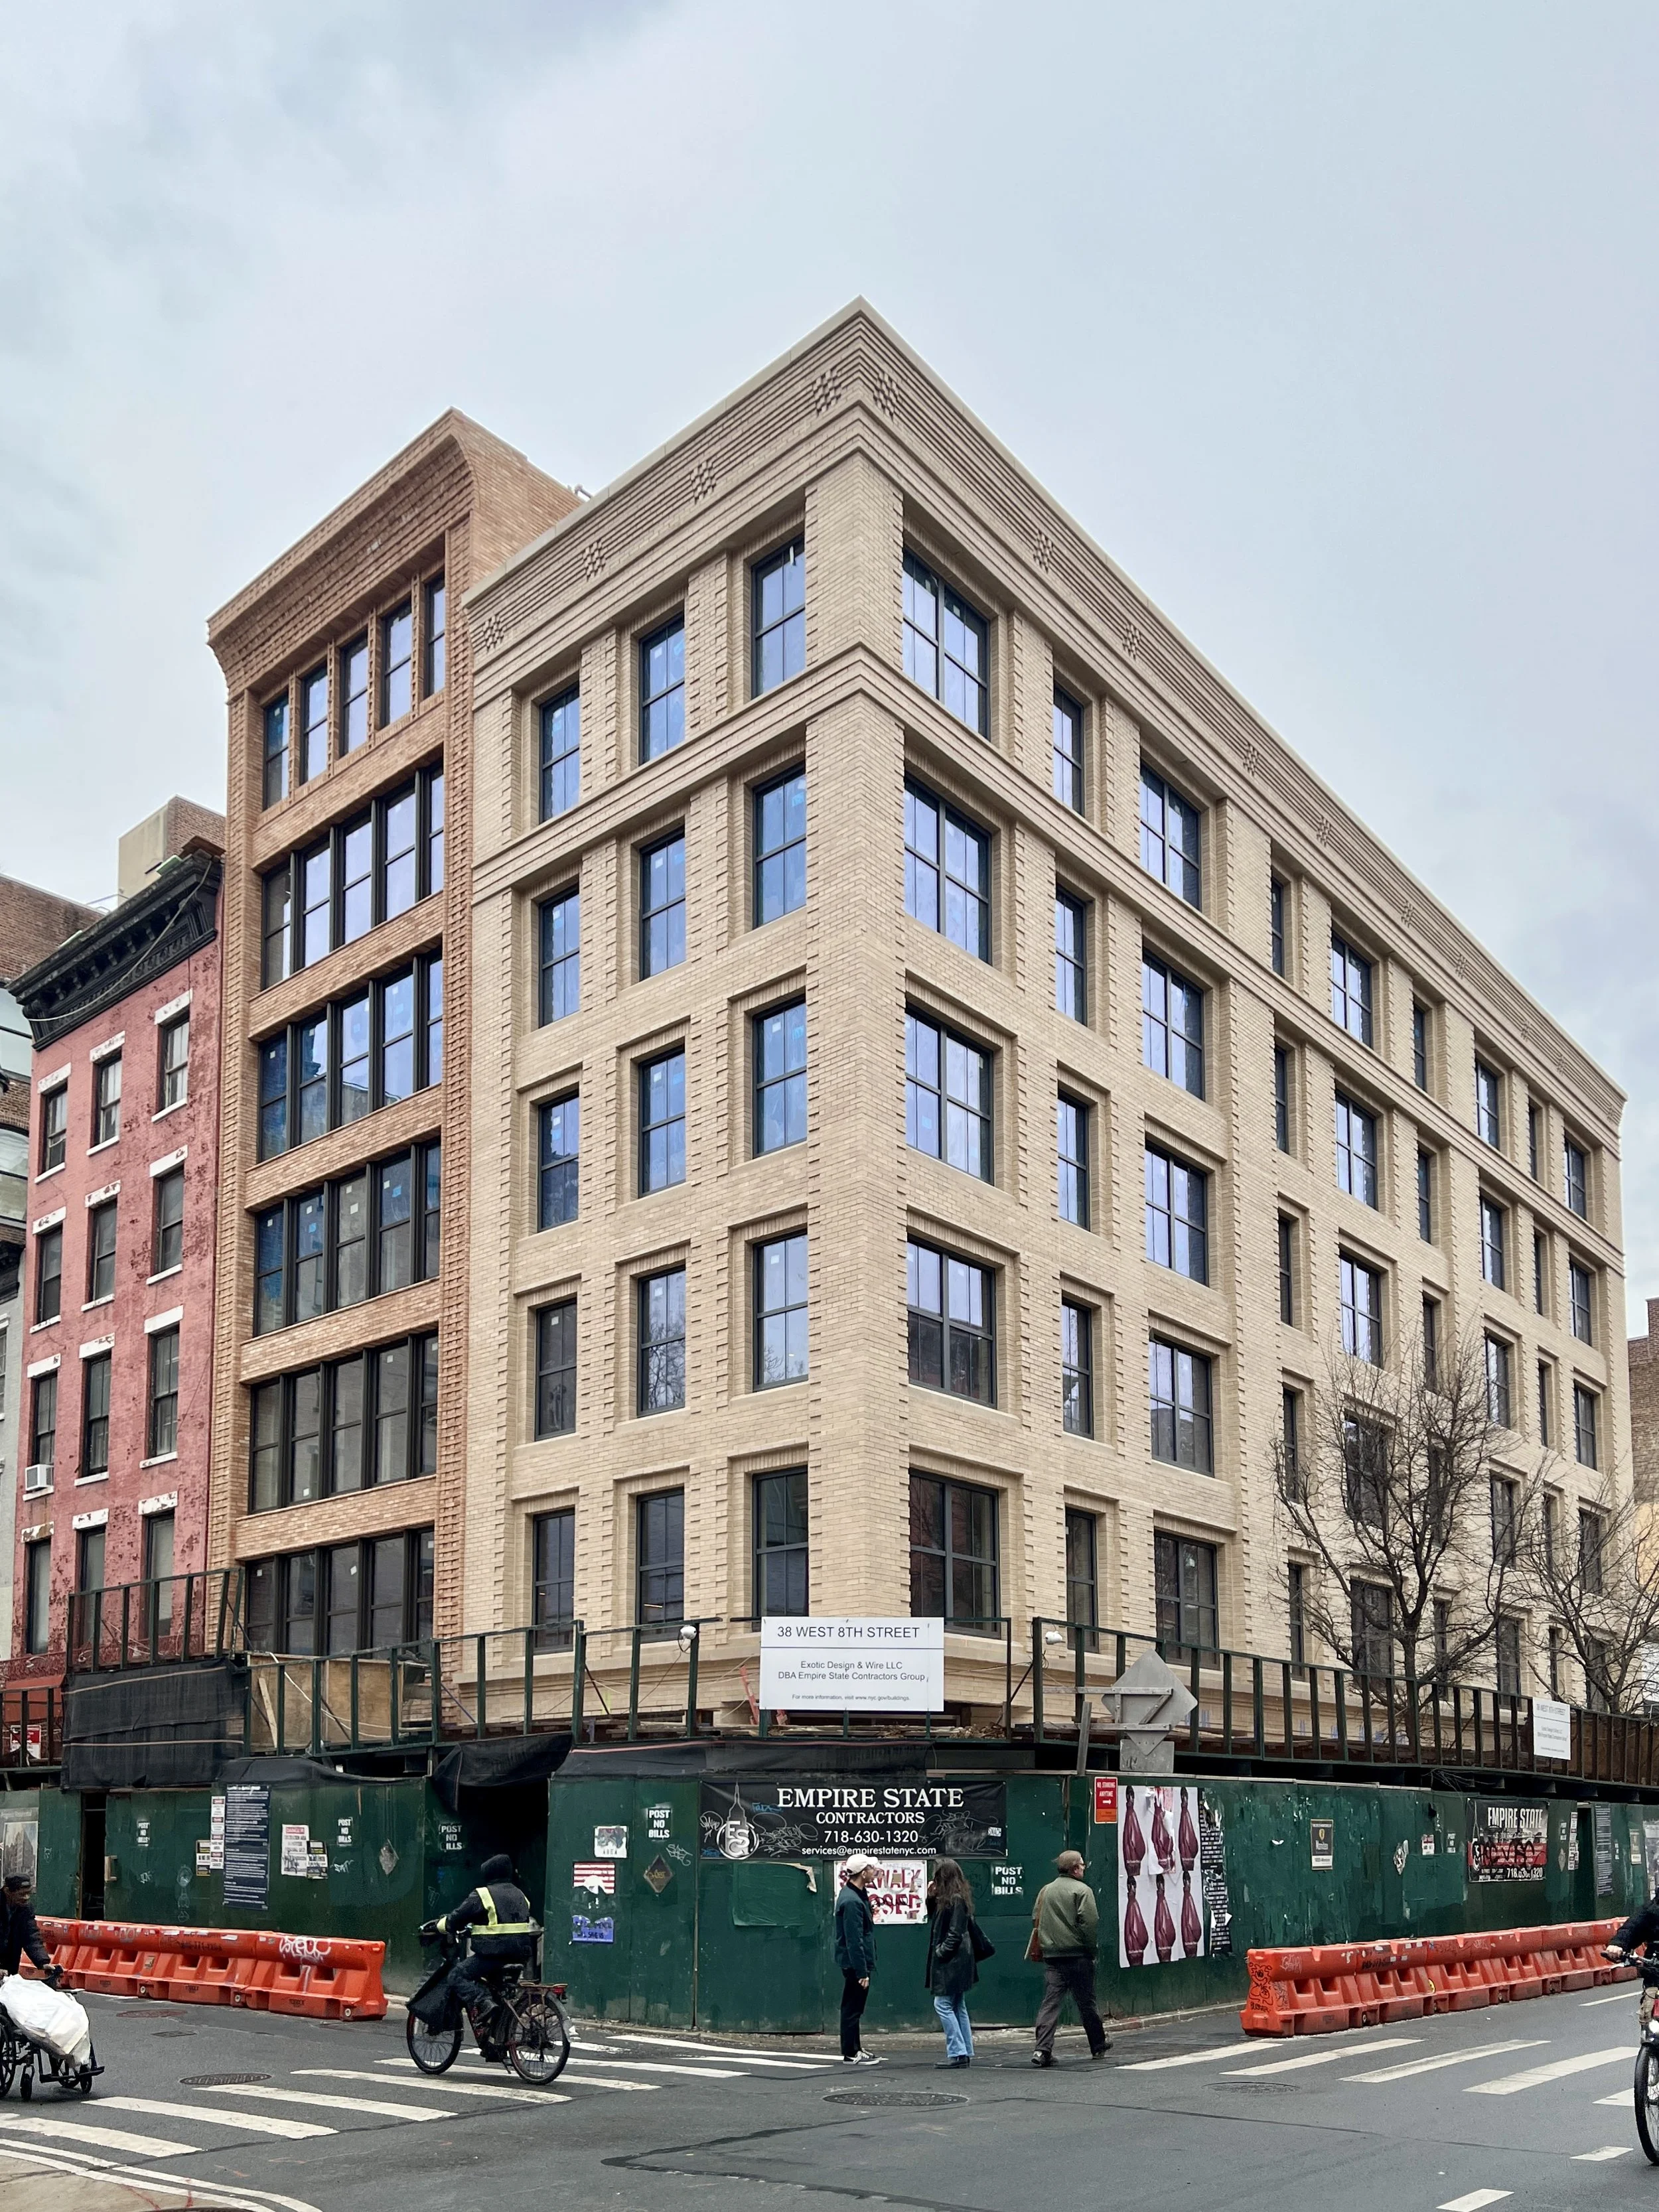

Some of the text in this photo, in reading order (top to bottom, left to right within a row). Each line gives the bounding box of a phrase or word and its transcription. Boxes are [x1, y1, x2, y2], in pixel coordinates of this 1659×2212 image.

[777, 1626, 920, 1638] 38 WEST 8TH STREET
[828, 1661, 855, 1671] Design
[798, 1672, 826, 1681] Empire
[901, 1673, 925, 1682] Group
[777, 1788, 964, 1808] EMPIRE STATE
[649, 1810, 670, 1819] POST
[816, 1812, 925, 1824] CONTRACTORS
[1487, 1807, 1543, 1829] EMPIRE STATE
[654, 1819, 665, 1828] NO
[648, 1829, 670, 1838] BILLS
[824, 1831, 918, 1842] 718-630-1320
[802, 1846, 936, 1856] services@empirestatenyc.com
[995, 1866, 1023, 1875] POST
[1001, 1876, 1016, 1885] NO
[994, 1886, 1023, 1895] BILLS
